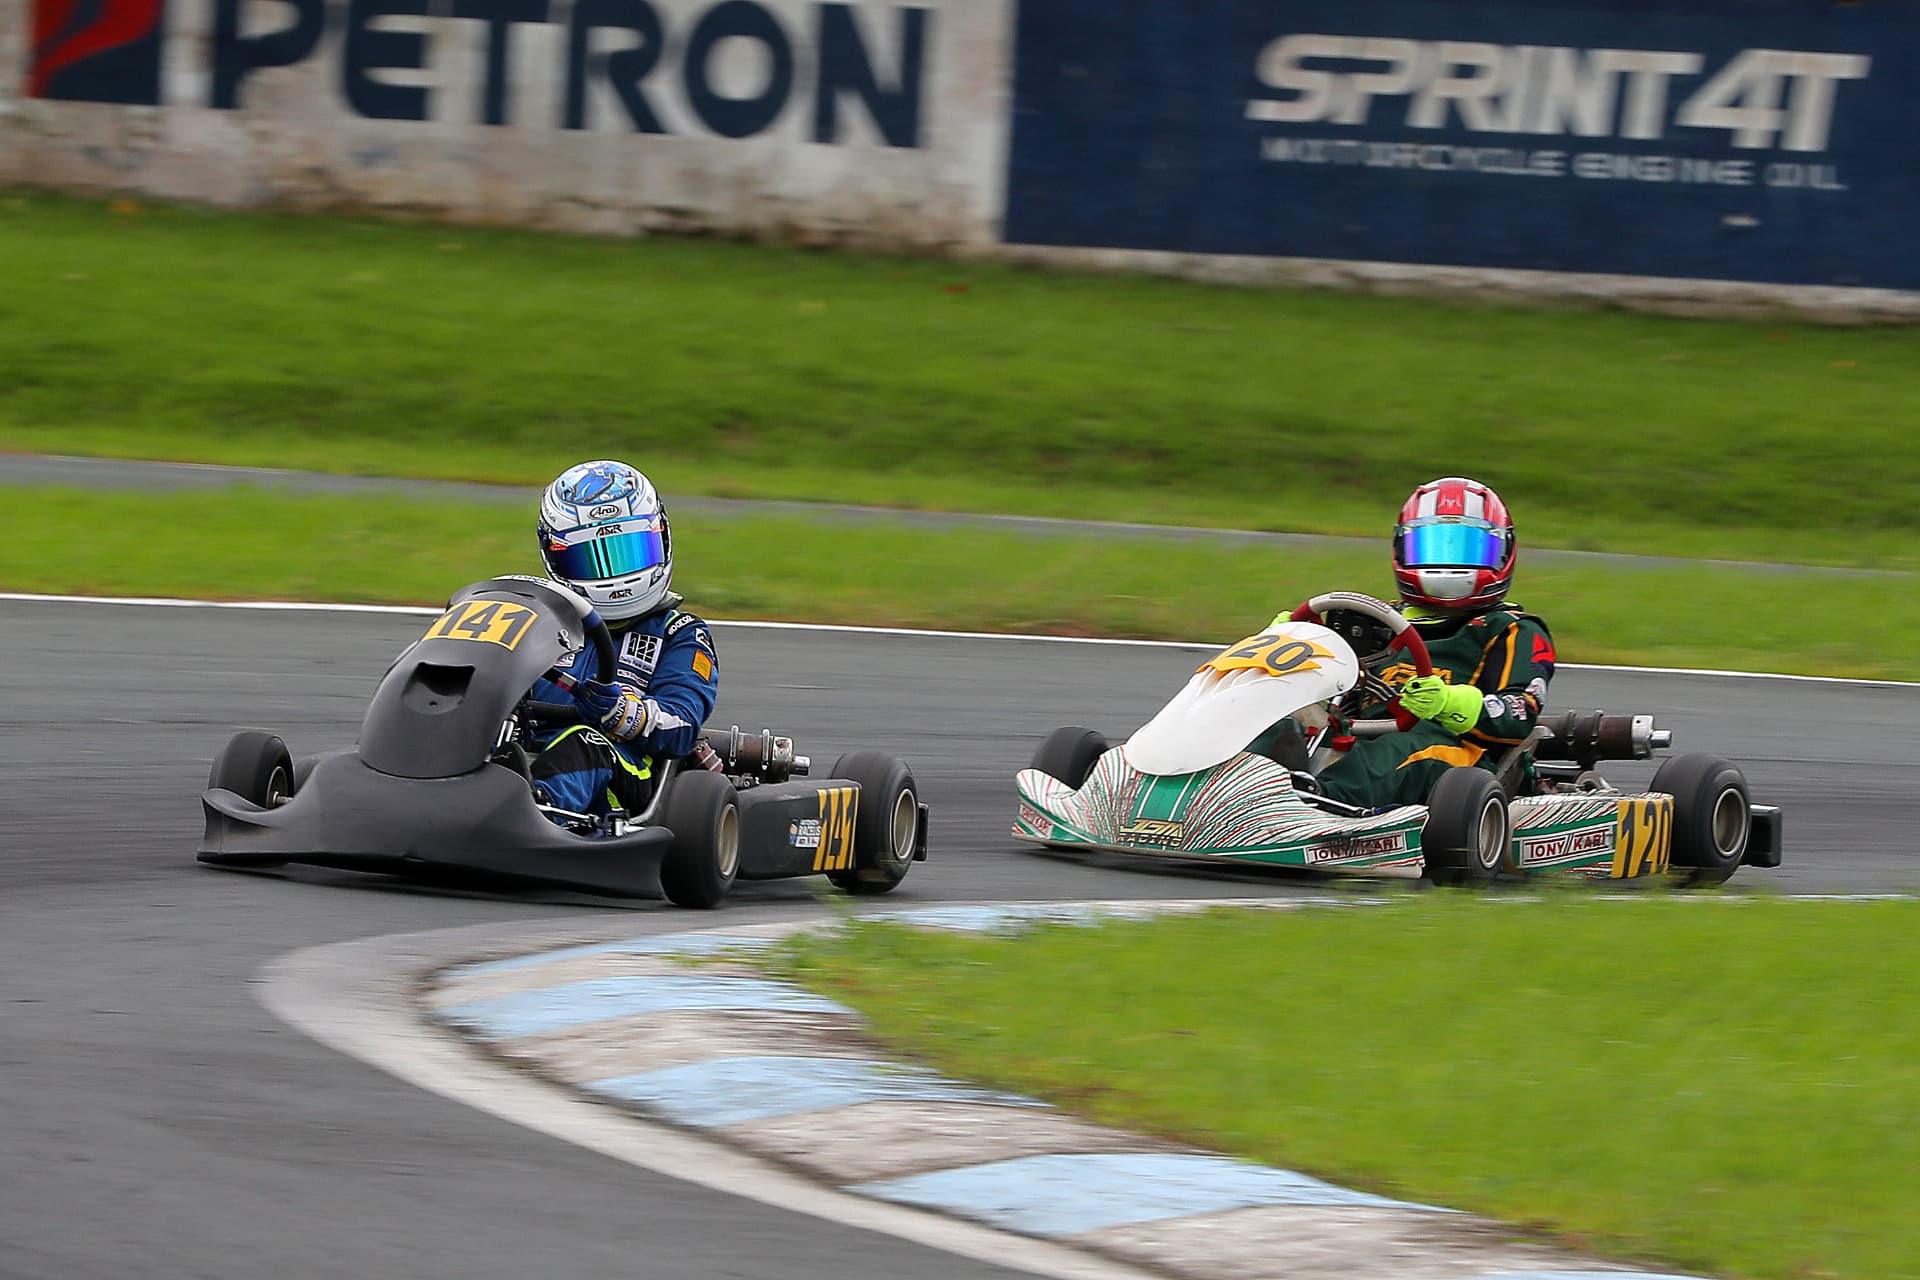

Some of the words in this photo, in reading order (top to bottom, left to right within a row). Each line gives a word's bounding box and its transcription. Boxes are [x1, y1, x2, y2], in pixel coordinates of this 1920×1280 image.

[212, 0, 928, 149] PETRON
[1261, 138, 1565, 178] MOTORCYCLE
[436, 601, 534, 646] 141
[1226, 634, 1314, 672] 20
[822, 787, 857, 871] 141
[1117, 833, 1182, 847] RACING
[1620, 801, 1671, 878] 120
